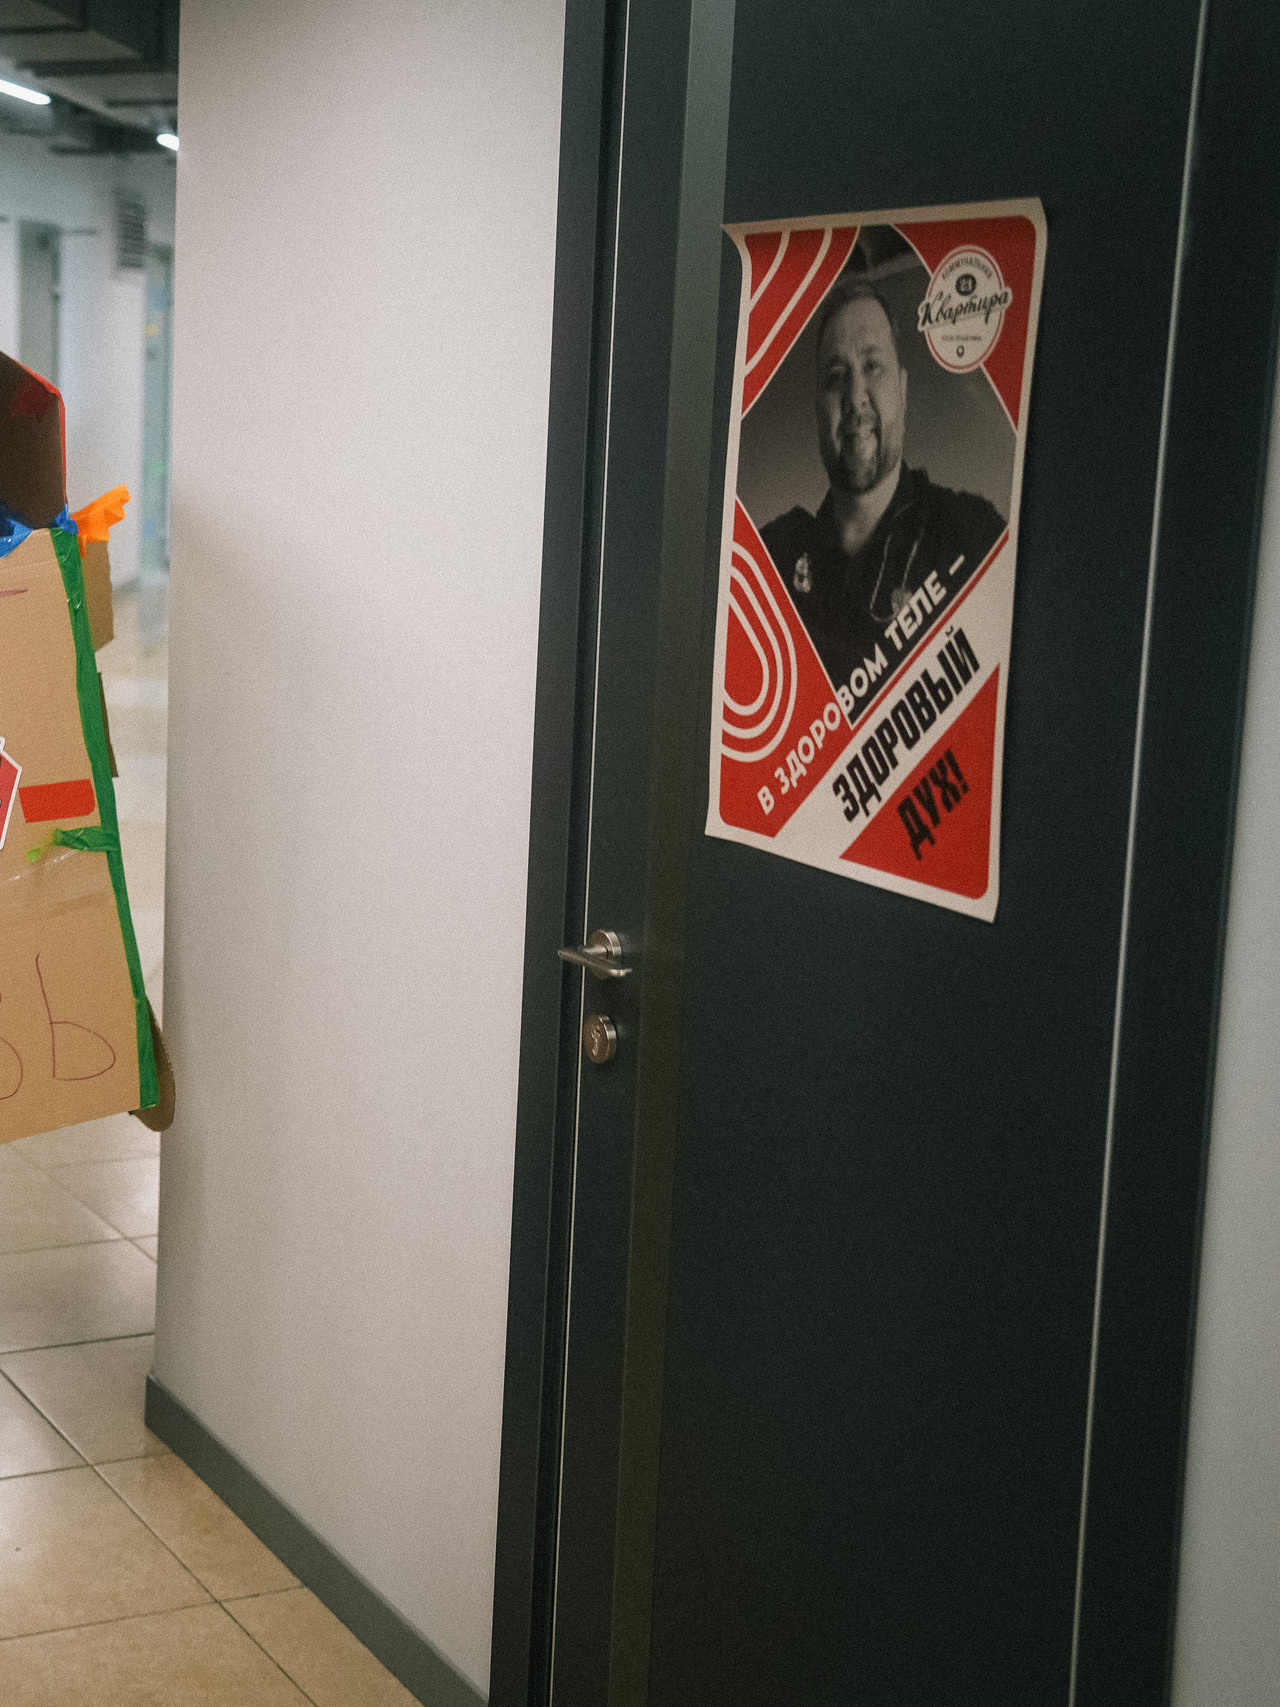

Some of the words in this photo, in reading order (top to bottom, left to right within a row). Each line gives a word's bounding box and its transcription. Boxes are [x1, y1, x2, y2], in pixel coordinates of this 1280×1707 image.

[920, 290, 1009, 326] Квартира
[757, 786, 775, 815] В
[774, 644, 889, 794] ЗДОРОВОМ
[884, 570, 947, 651] ТЕЛЕ
[832, 625, 980, 823] ЗДОРОВЫЙ
[896, 749, 970, 861] ДУХ!
